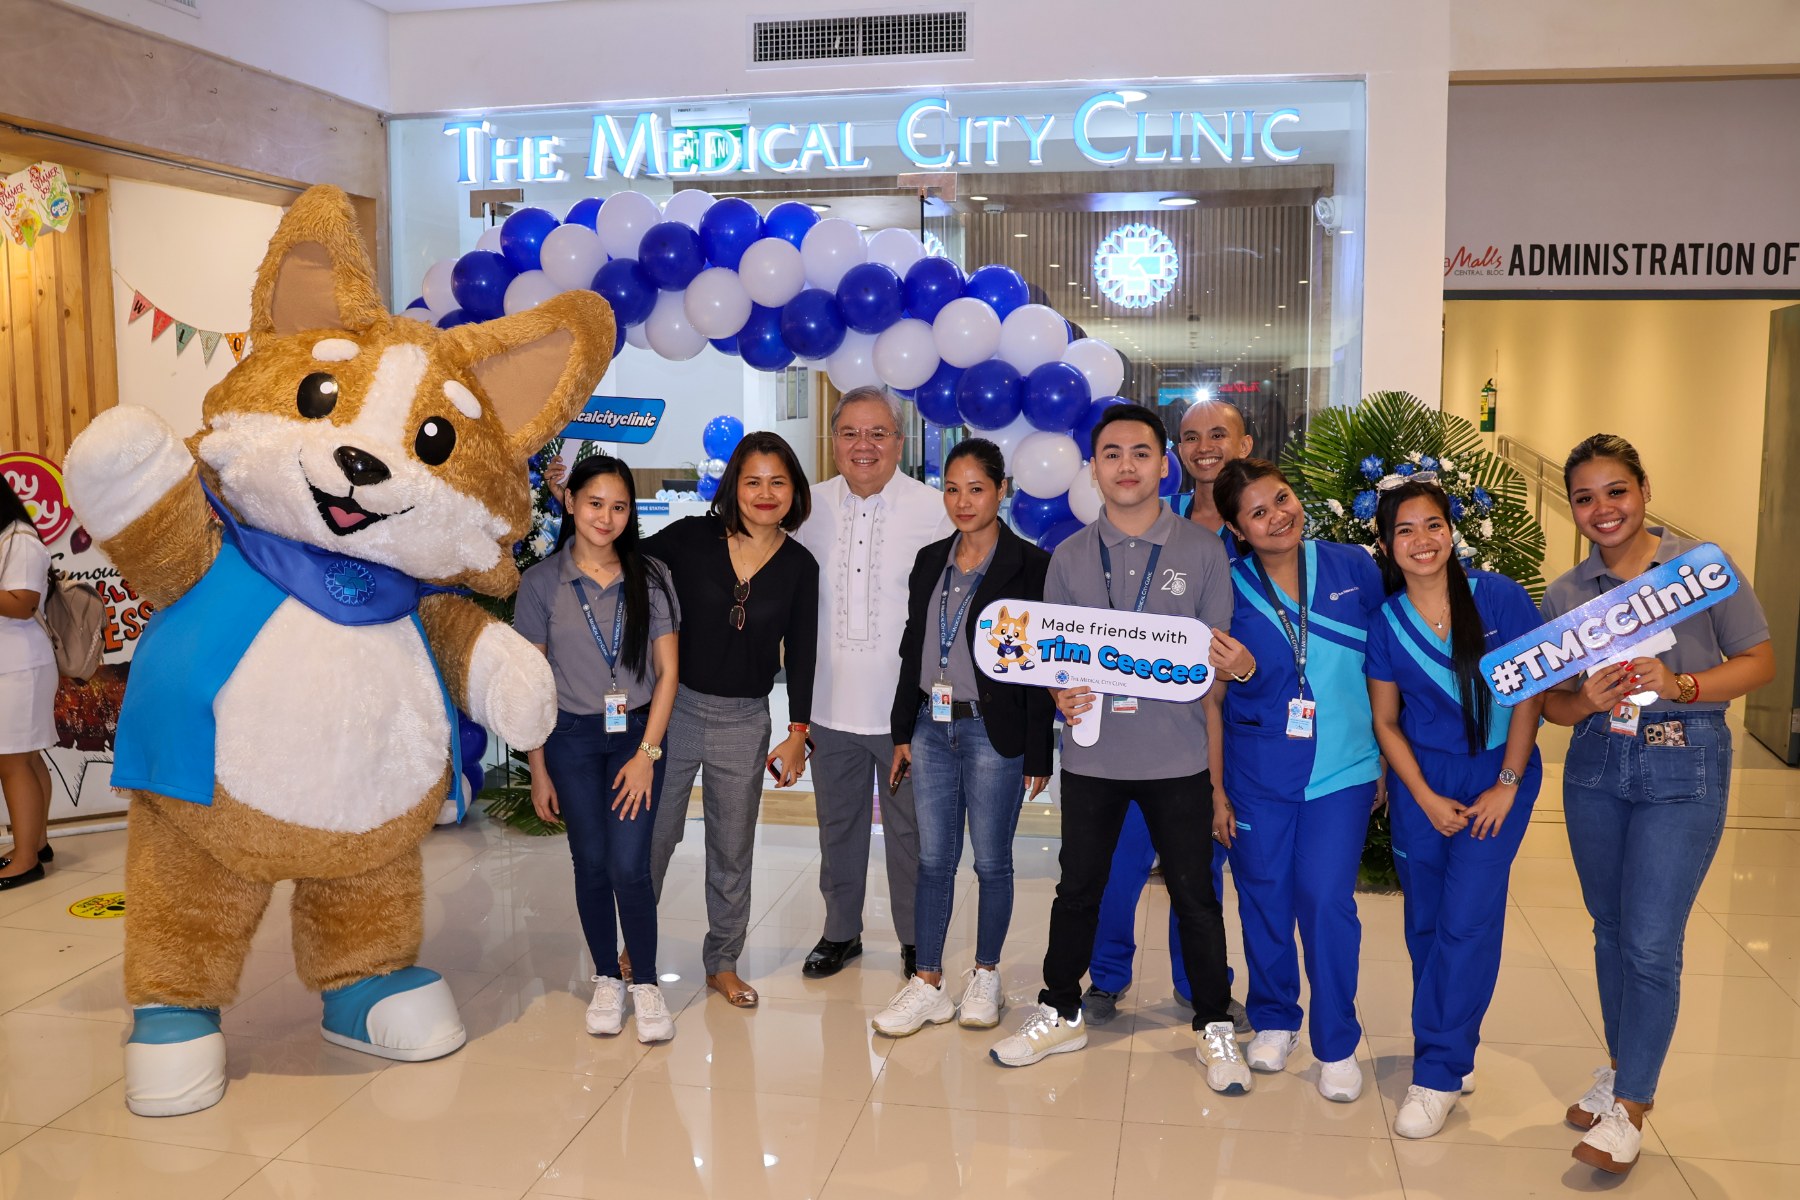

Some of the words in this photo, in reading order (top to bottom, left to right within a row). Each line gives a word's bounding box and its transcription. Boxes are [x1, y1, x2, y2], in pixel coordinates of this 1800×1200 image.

[443, 117, 567, 184] THE
[584, 111, 870, 179] MEDICAL
[897, 97, 1055, 168] CITY
[1073, 90, 1302, 166] CLINIC
[1507, 243, 1755, 276] ADMINISTRATION
[573, 409, 657, 428] calcityclinic
[1041, 617, 1085, 634] Made
[1090, 621, 1147, 641] friends
[1152, 630, 1188, 645] with
[1036, 635, 1091, 665] Tim
[1097, 645, 1209, 685] CeeCee
[1079, 677, 1101, 685] MEDICAL
